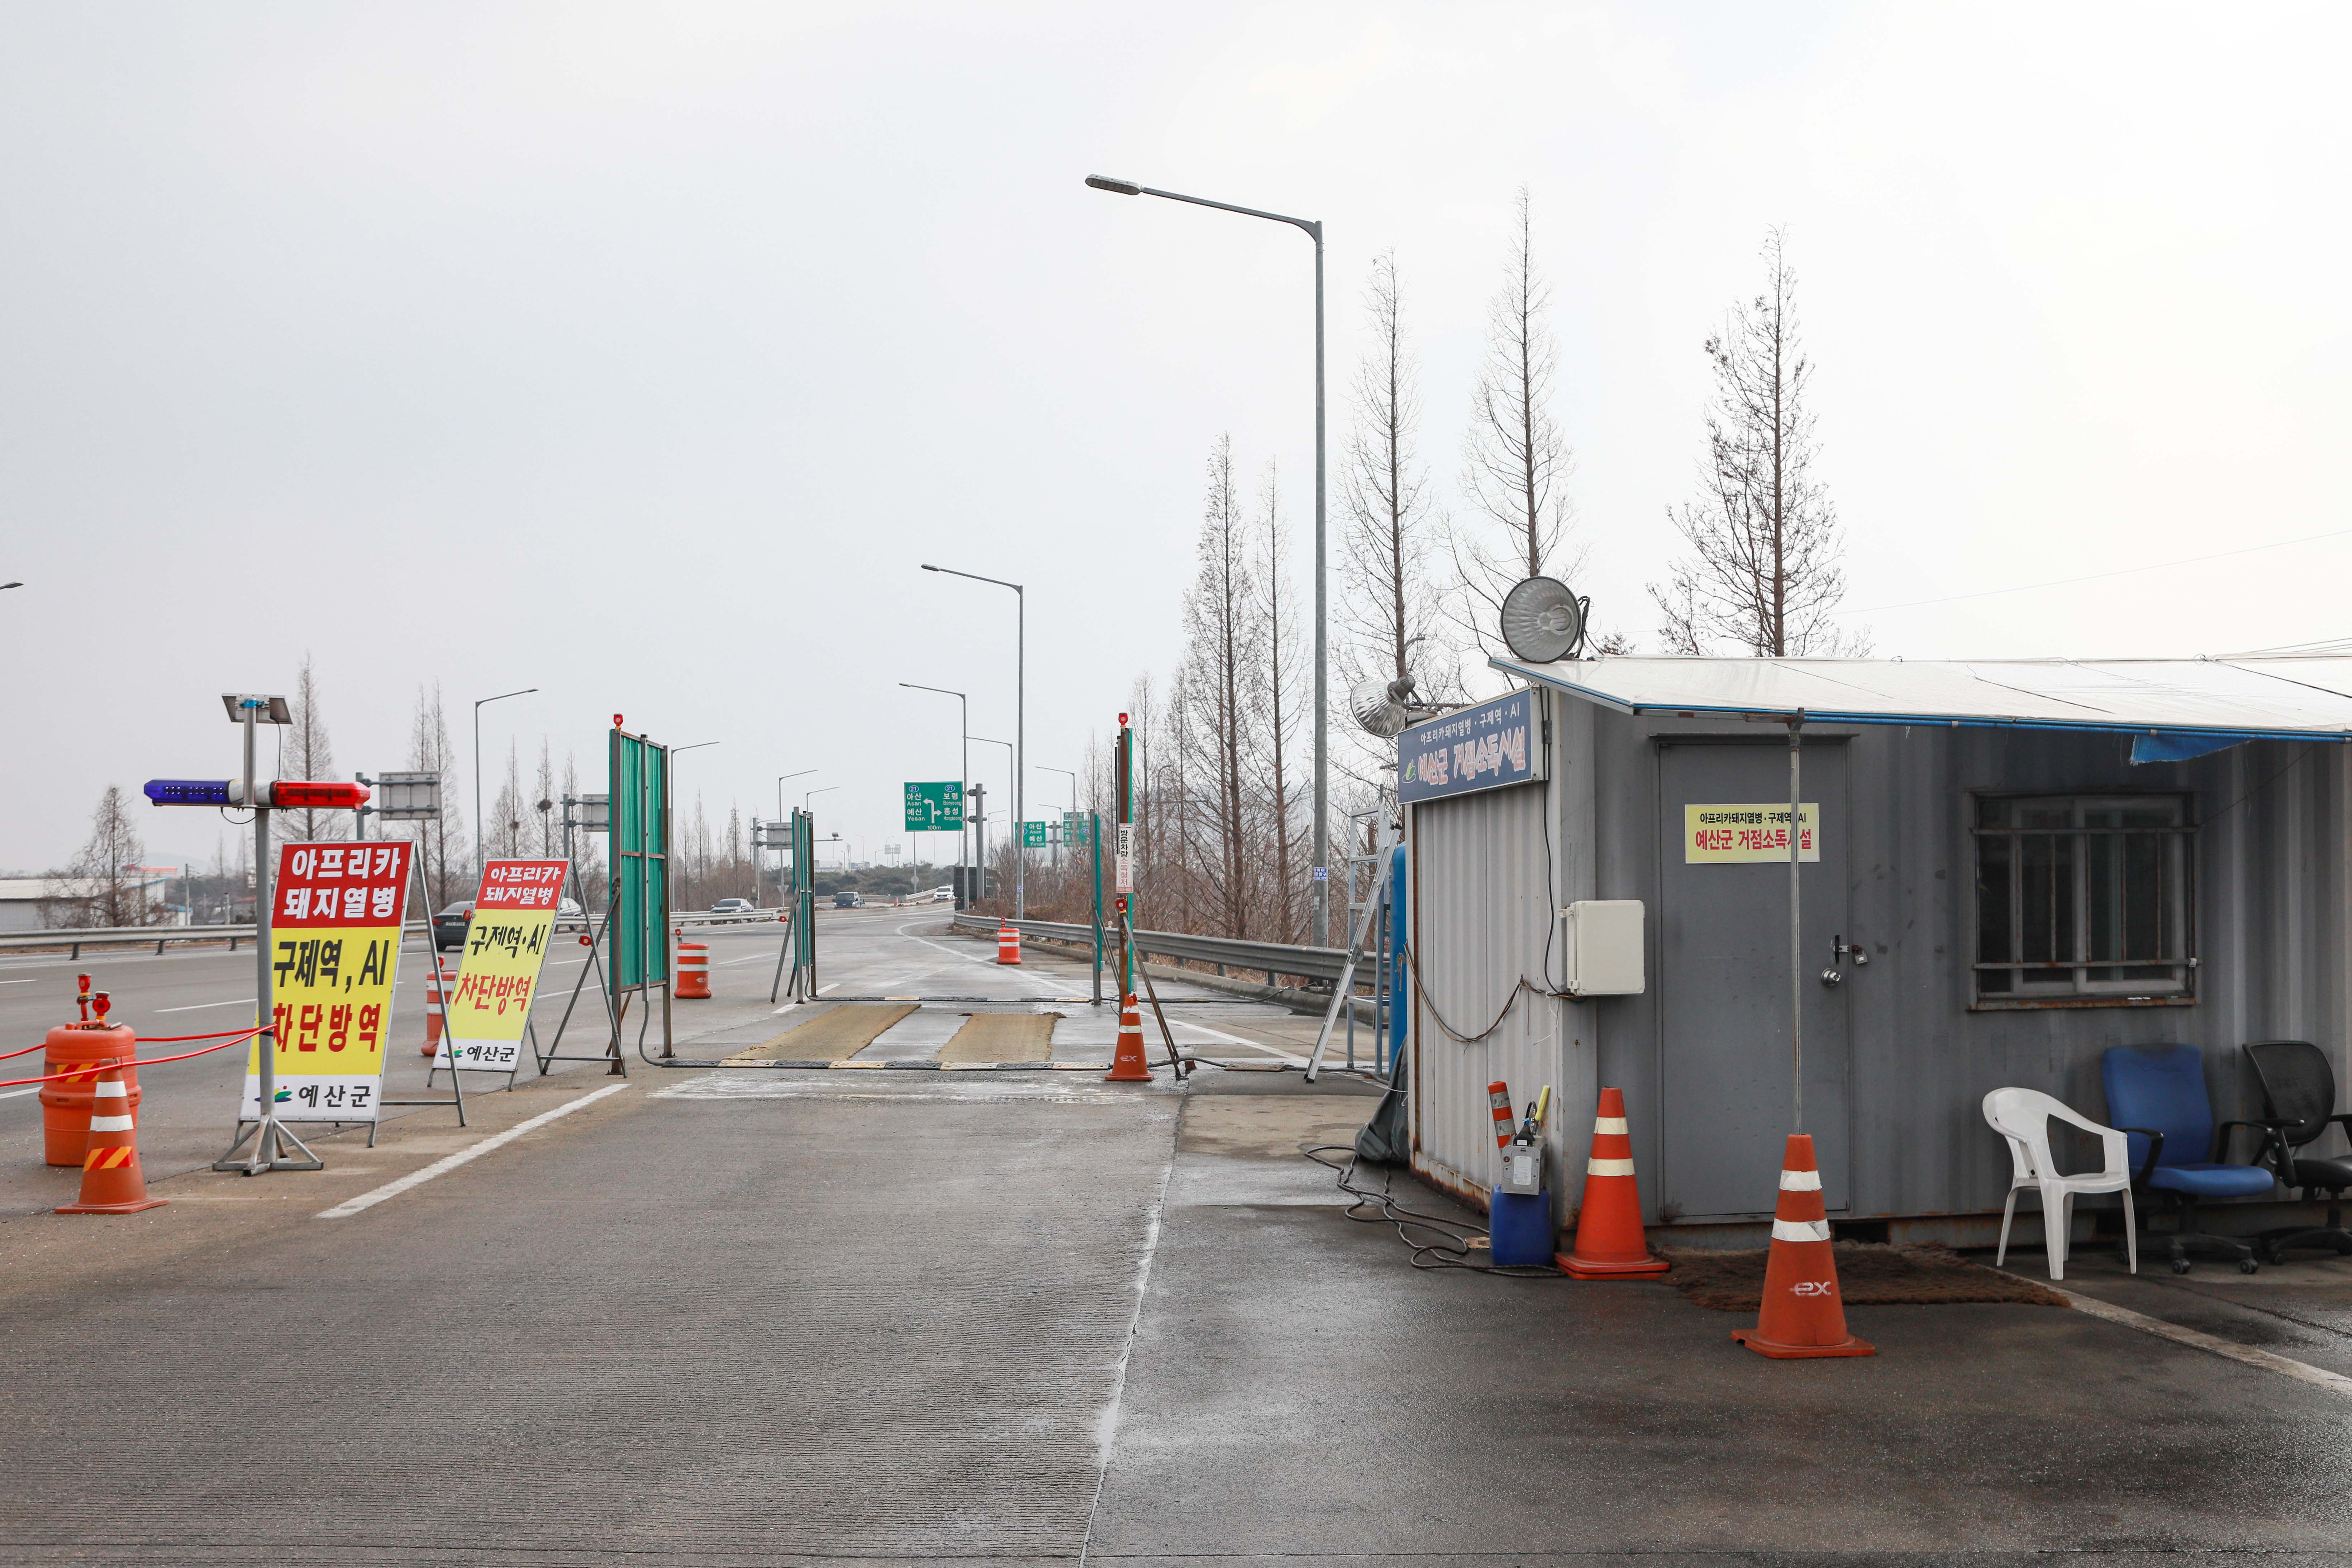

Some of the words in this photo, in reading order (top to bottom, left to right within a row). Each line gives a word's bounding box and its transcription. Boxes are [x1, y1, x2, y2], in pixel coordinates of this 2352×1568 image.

[1420, 717, 1471, 745] 아프리카돼지열병
[1510, 702, 1520, 718] AI
[1418, 748, 1448, 786] 예산군
[1453, 725, 1526, 781] 거점소독시설
[1700, 812, 1762, 824] 아프리카돼지열병
[1120, 830, 1128, 858] 방문차량
[1695, 829, 1733, 850] 예산군
[292, 847, 401, 880] 아프리카
[491, 867, 561, 883] 아프리카
[1120, 858, 1128, 886] 소독철저
[283, 886, 396, 919] 돼지열병
[484, 887, 554, 905] 돼지열병
[358, 940, 390, 985] AI
[454, 972, 532, 1016] 차단방역
[273, 1003, 381, 1052] 차단방역
[467, 1045, 515, 1062] 예산군
[299, 1085, 371, 1107] 예산군
